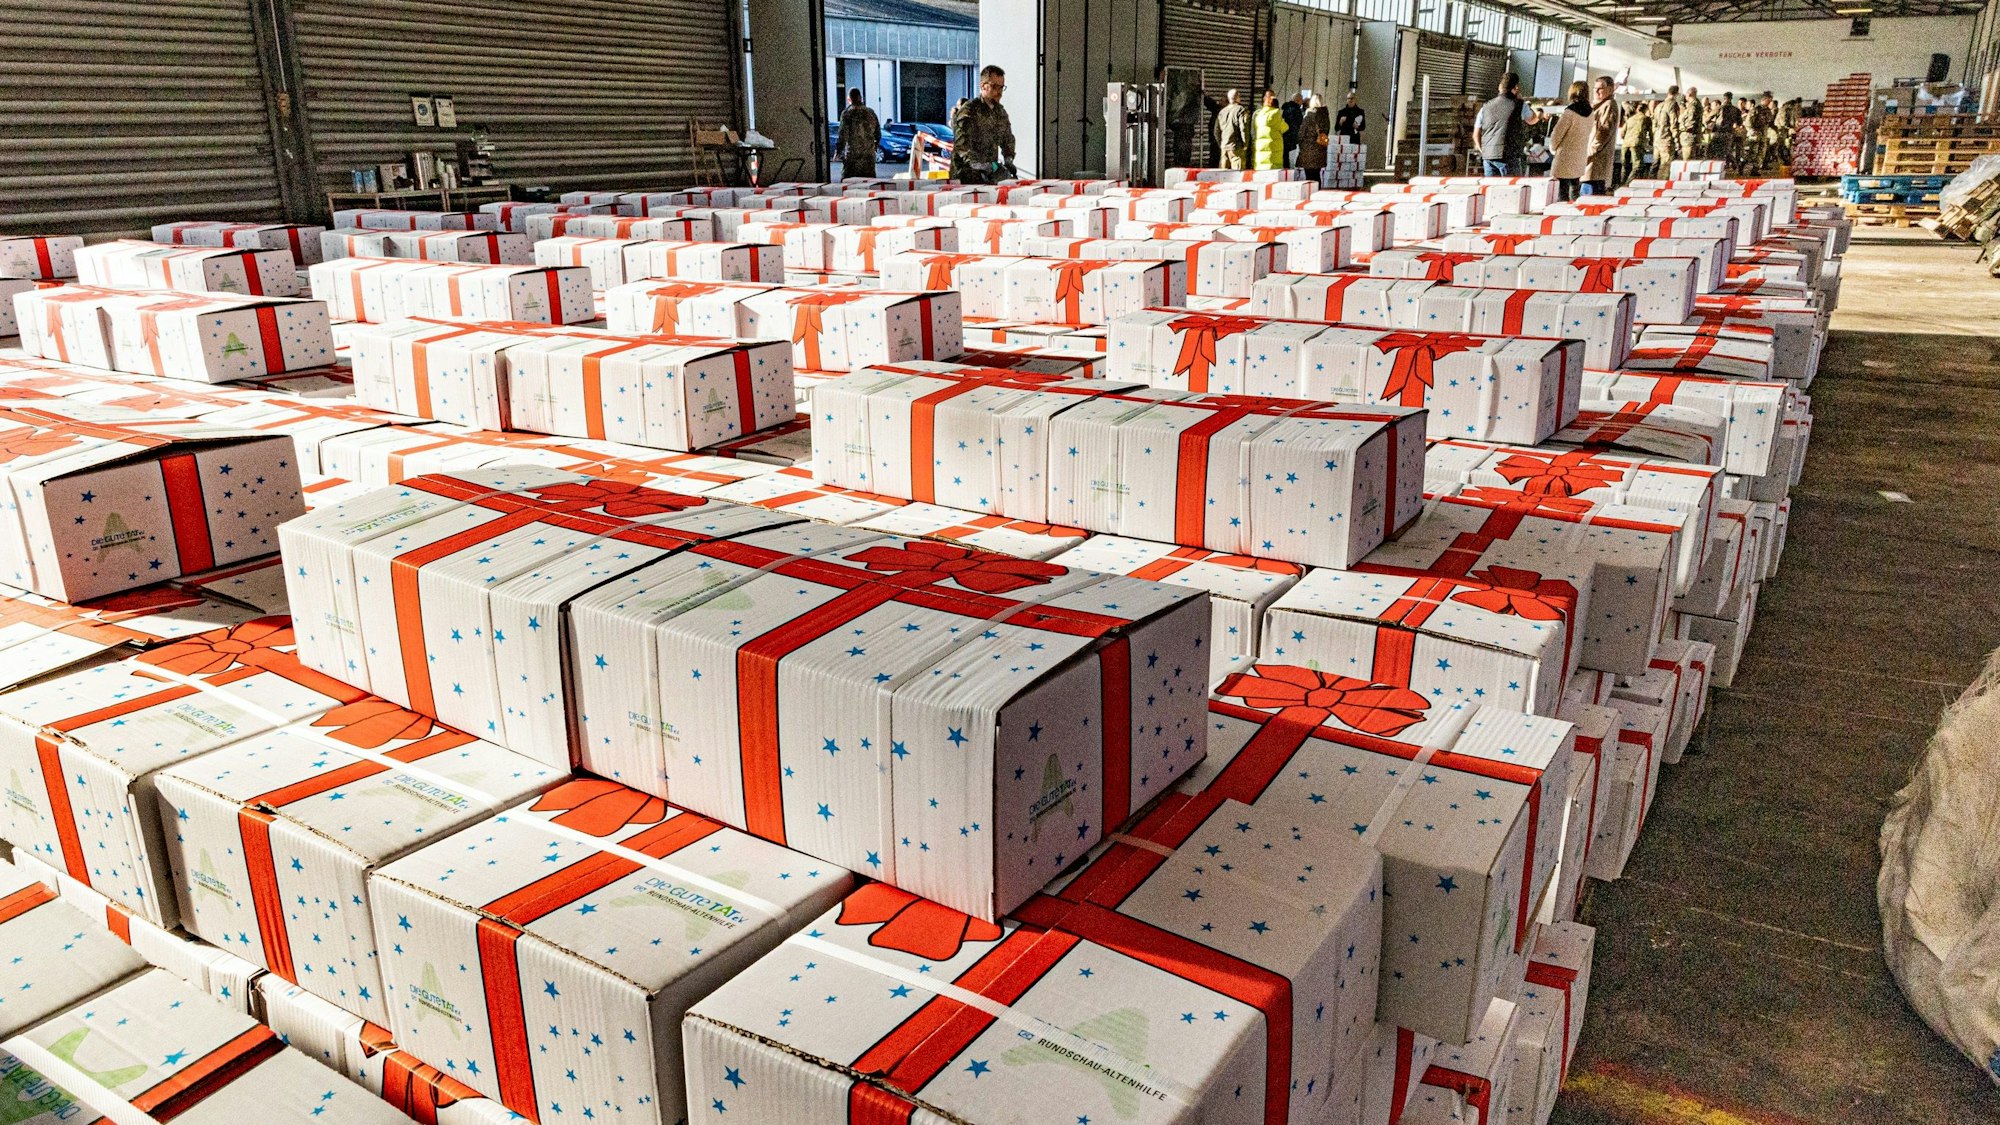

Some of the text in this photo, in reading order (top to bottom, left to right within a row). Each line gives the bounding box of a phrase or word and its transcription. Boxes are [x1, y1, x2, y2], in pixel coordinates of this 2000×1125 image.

[647, 890, 737, 930] RUNDSCHAU-ALTENHILFE
[708, 901, 741, 919] TAT
[1037, 1037, 1168, 1102] RUNDSCHAU-ALTENHILFE
